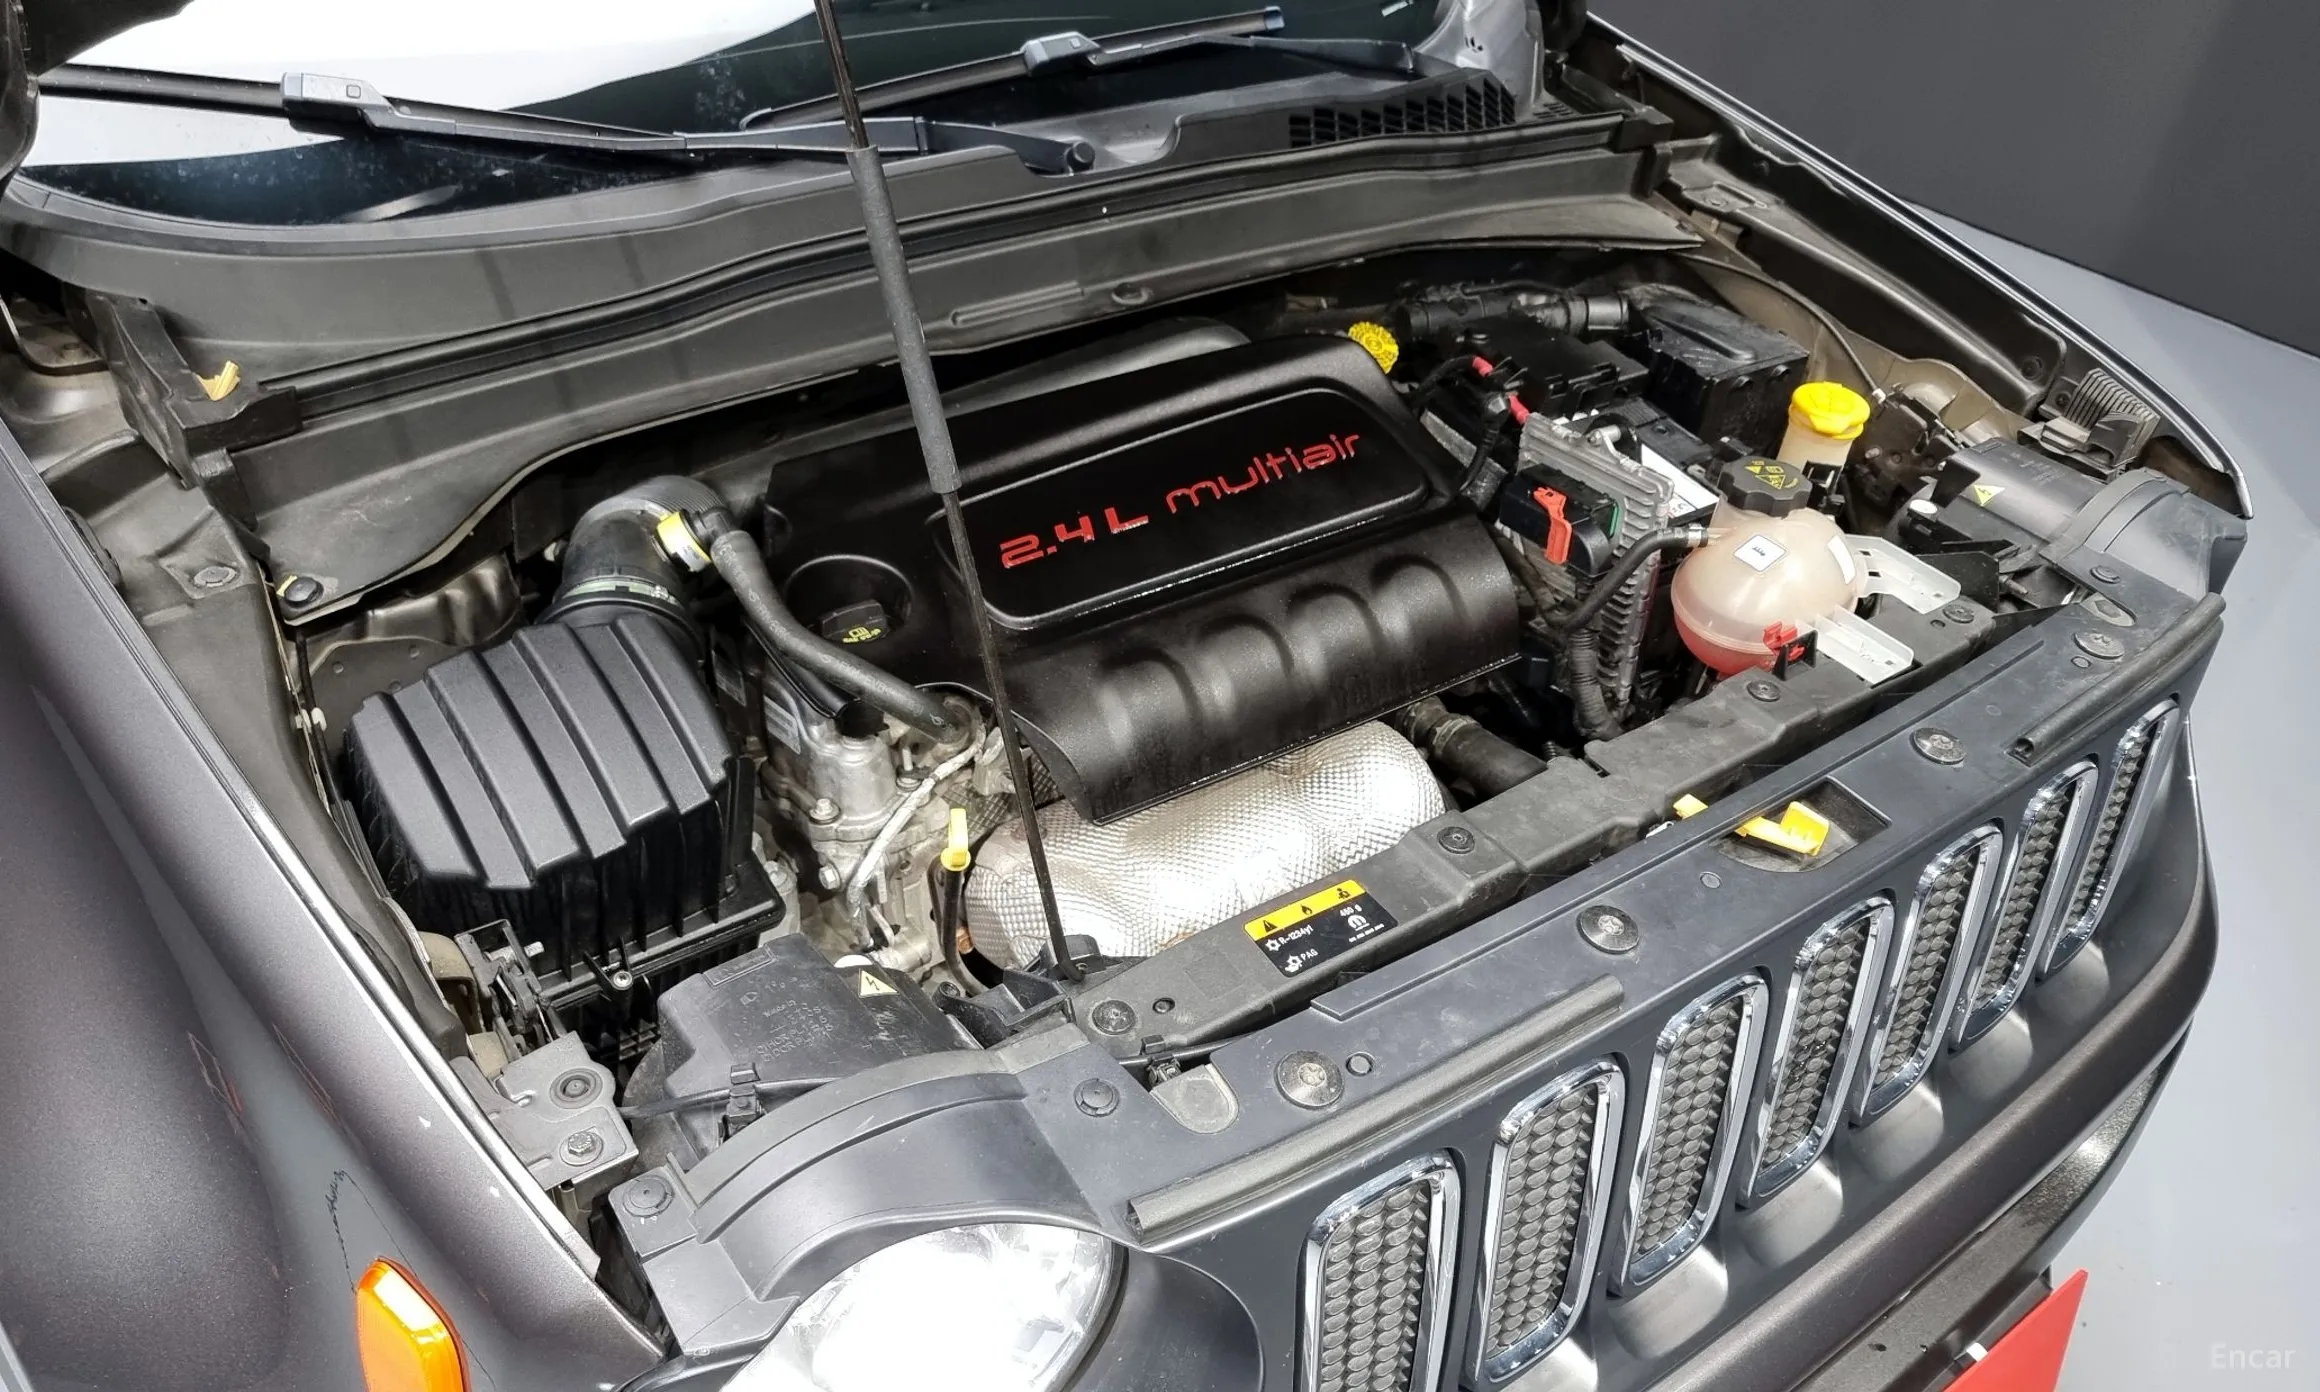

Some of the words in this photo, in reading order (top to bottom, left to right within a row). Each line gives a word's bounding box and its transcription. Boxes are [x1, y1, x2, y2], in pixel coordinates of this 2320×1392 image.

[1000, 516, 1095, 569] 2.4
[1104, 507, 1149, 535] L
[1166, 434, 1361, 514] multiair
[1300, 948, 1319, 961] PAG
